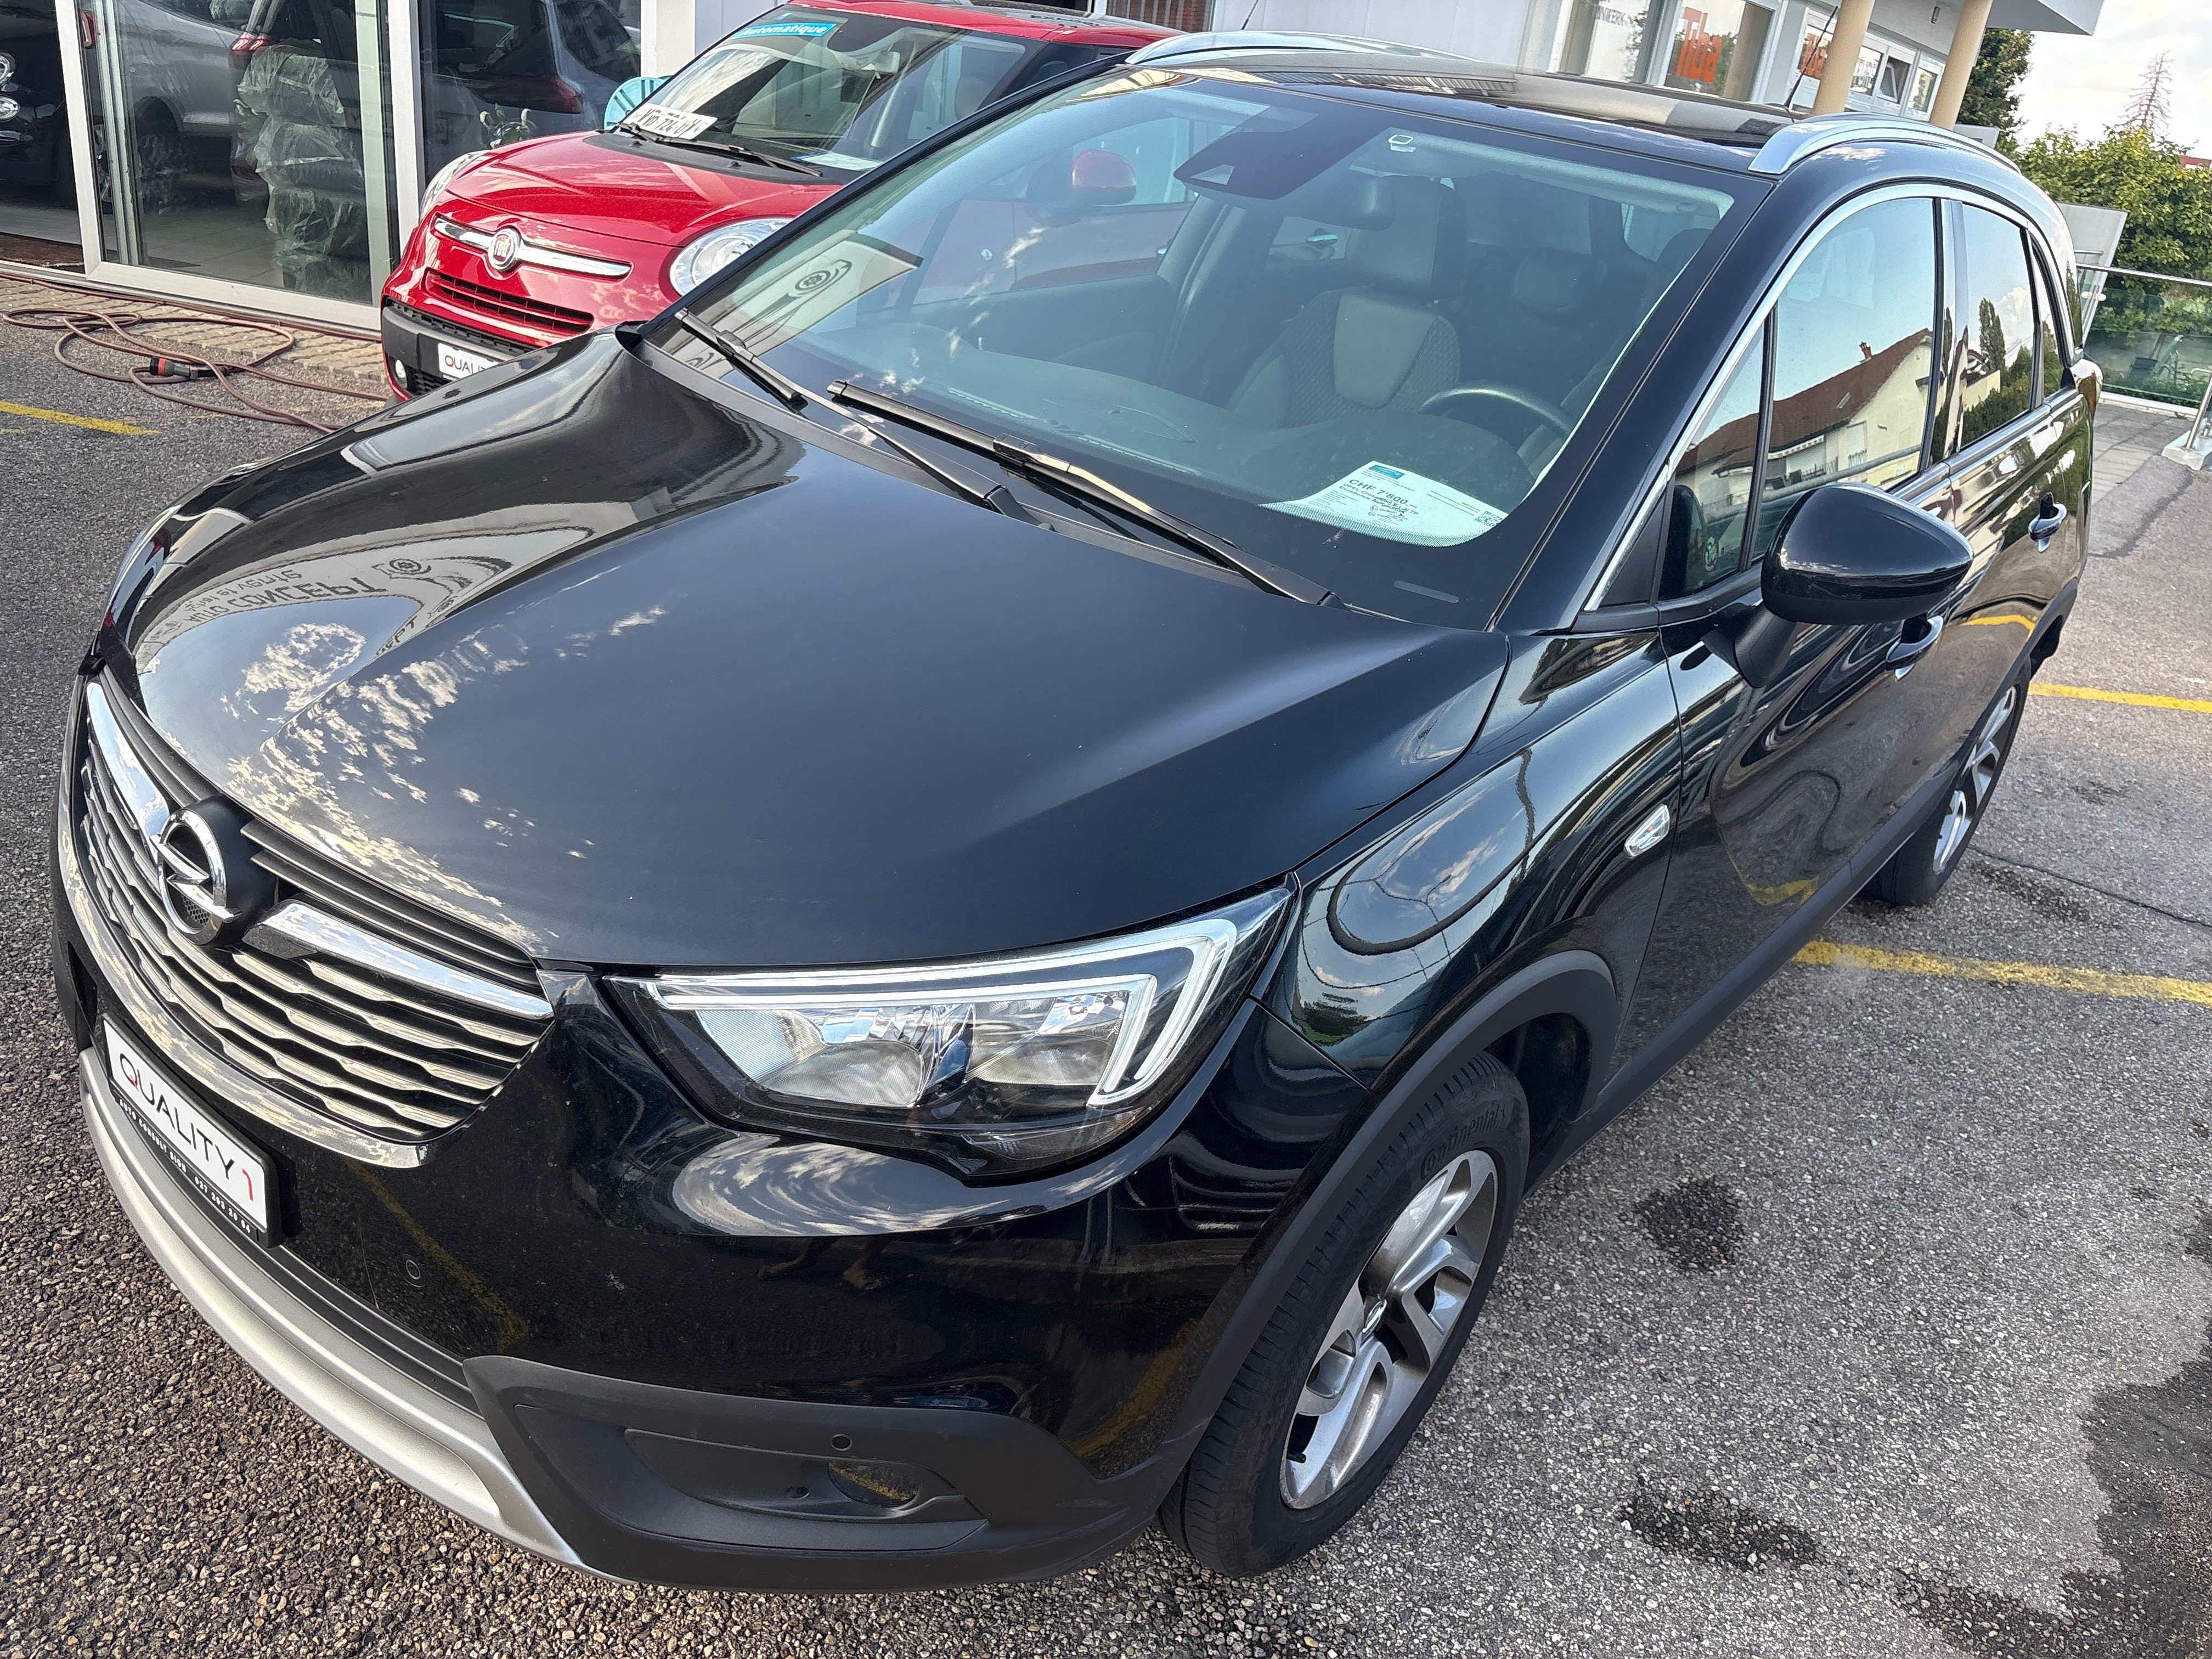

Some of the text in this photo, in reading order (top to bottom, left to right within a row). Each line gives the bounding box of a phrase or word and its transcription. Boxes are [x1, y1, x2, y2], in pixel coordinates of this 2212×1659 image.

[738, 24, 827, 36] Automatique
[1349, 479, 1376, 490] CHF
[120, 1098, 137, 1120] AUTO
[138, 1118, 167, 1153] CONSULT
[170, 1151, 187, 1172] SION
[195, 1176, 208, 1193] 027
[211, 1192, 225, 1210] 203
[228, 1207, 238, 1221] 20
